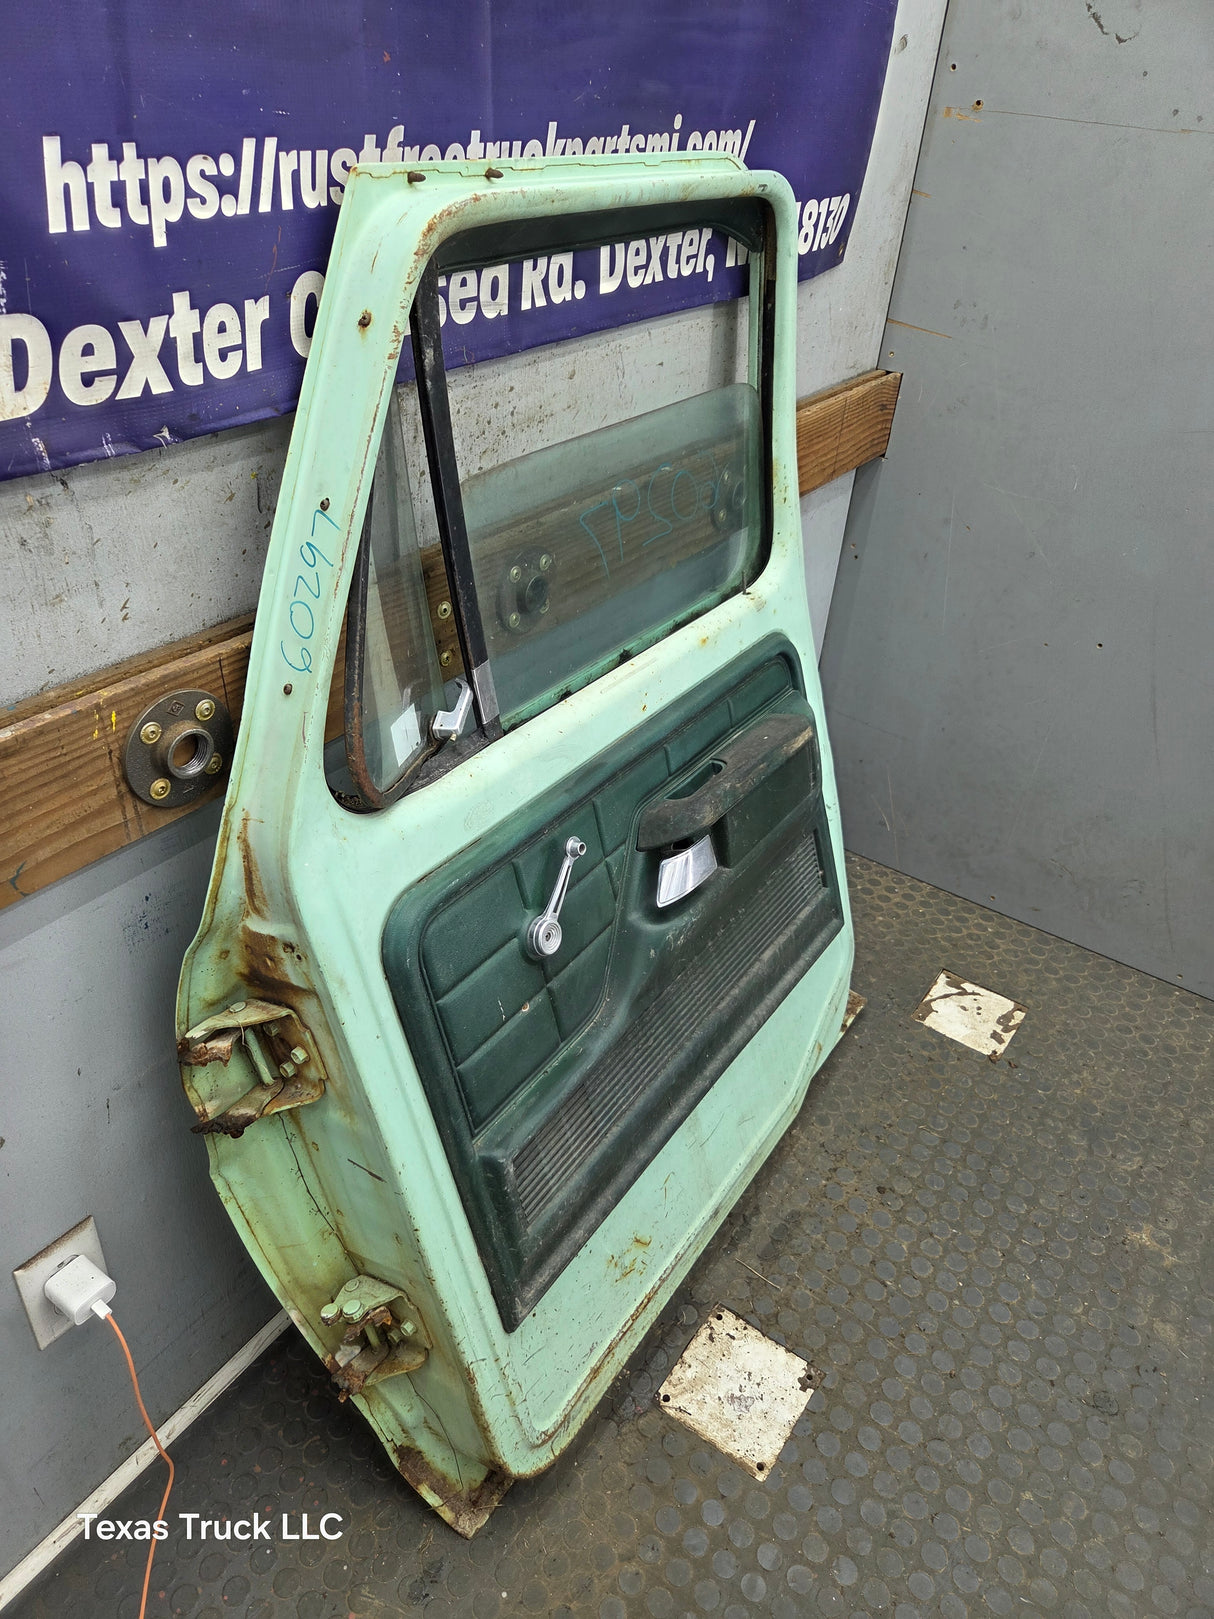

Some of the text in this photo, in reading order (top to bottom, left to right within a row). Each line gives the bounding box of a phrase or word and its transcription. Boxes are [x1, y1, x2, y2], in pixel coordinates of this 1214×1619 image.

[0, 290, 270, 422] Dexter
[599, 227, 714, 295] Dexter,
[796, 192, 851, 256] 8130
[280, 509, 342, 674] 60297
